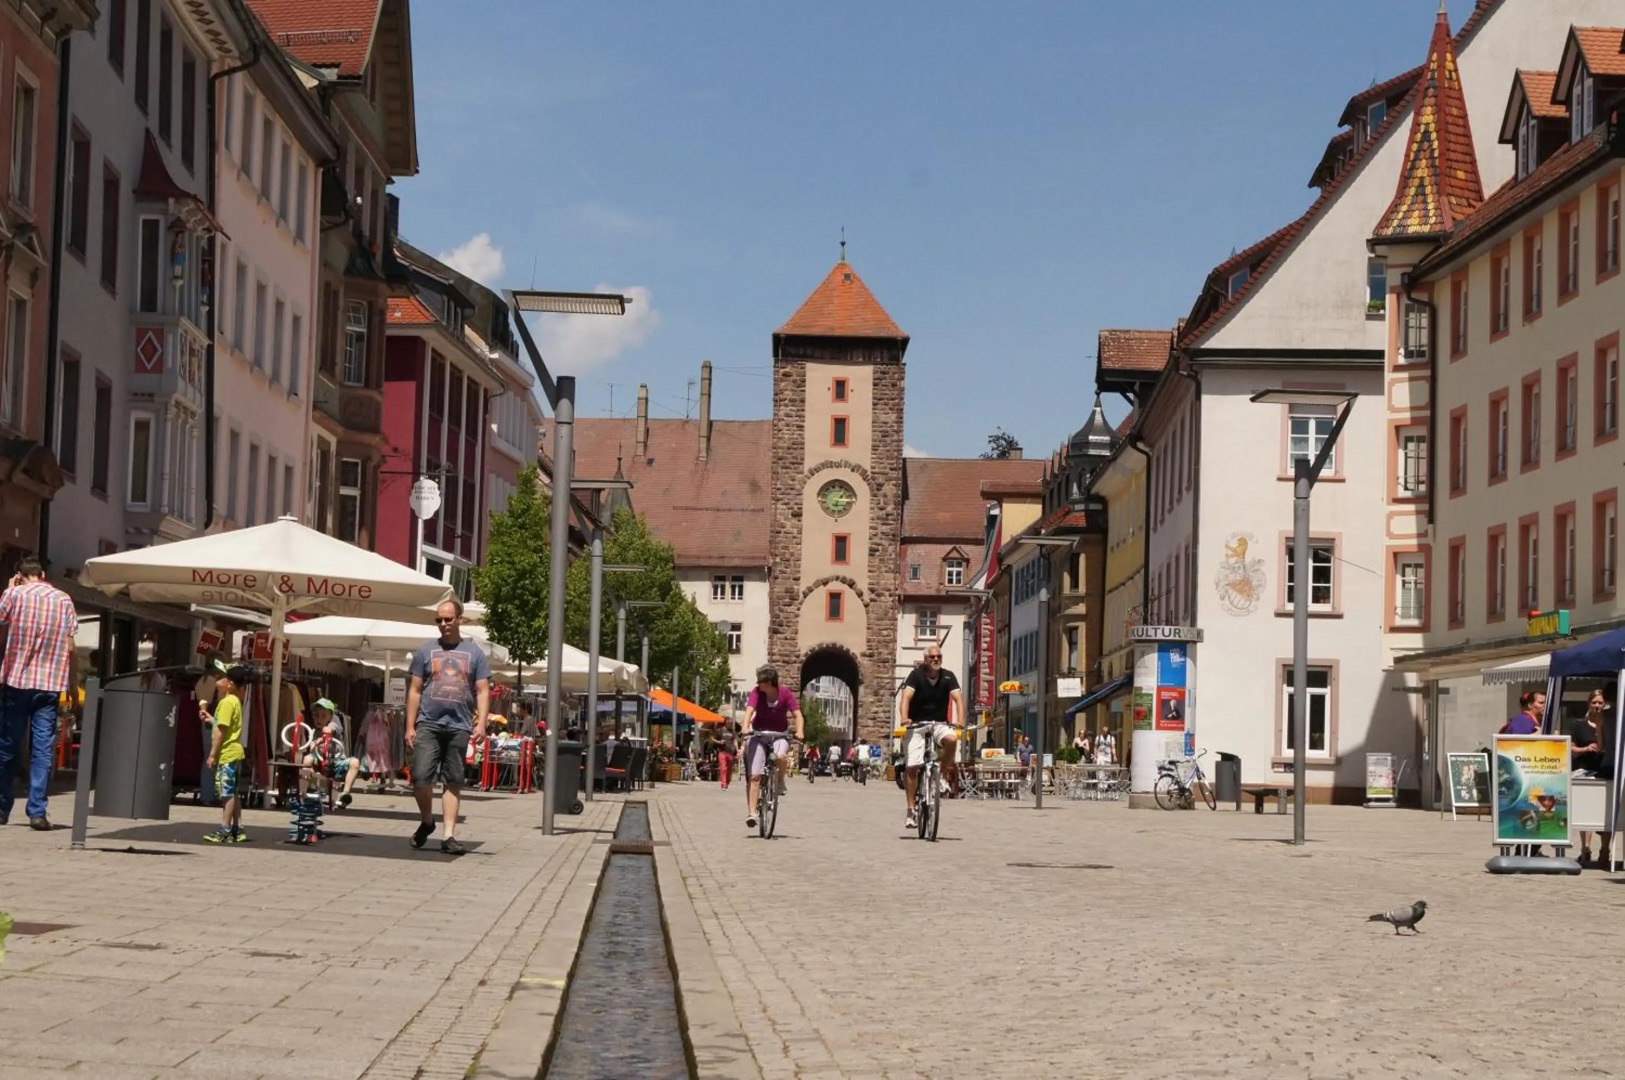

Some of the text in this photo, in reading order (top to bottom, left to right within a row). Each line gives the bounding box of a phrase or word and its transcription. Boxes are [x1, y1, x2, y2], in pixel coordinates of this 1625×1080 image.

[192, 569, 372, 599] More & More
[1515, 755, 1561, 763] Das Leben
